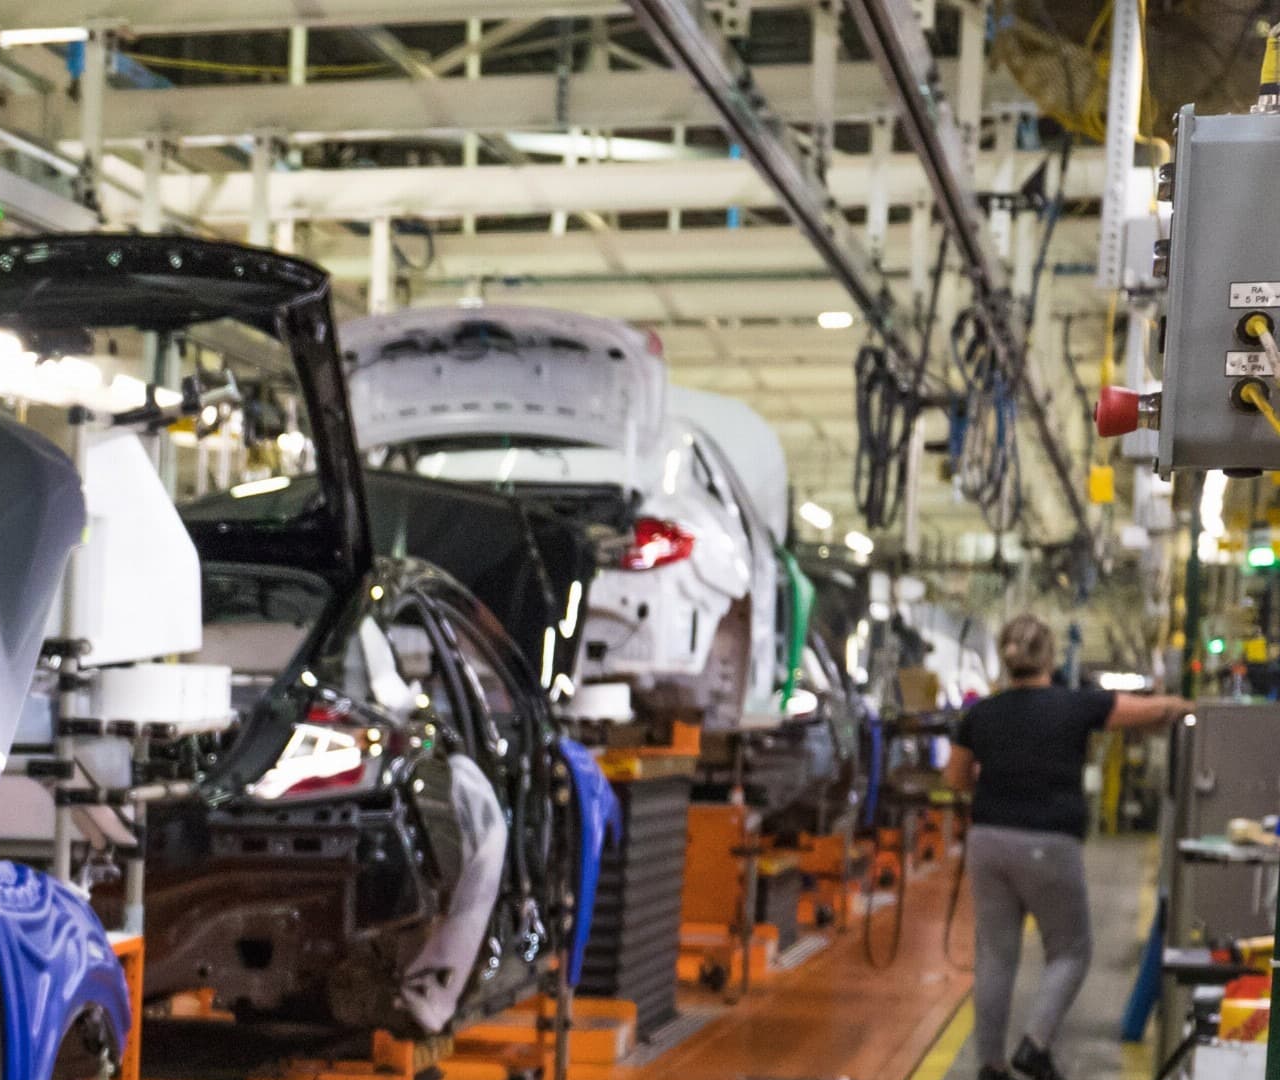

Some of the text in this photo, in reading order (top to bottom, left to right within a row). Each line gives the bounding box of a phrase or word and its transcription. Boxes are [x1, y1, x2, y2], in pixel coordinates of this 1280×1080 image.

[1245, 295, 1269, 303] 5 PIN
[1251, 364, 1265, 372] PIN
